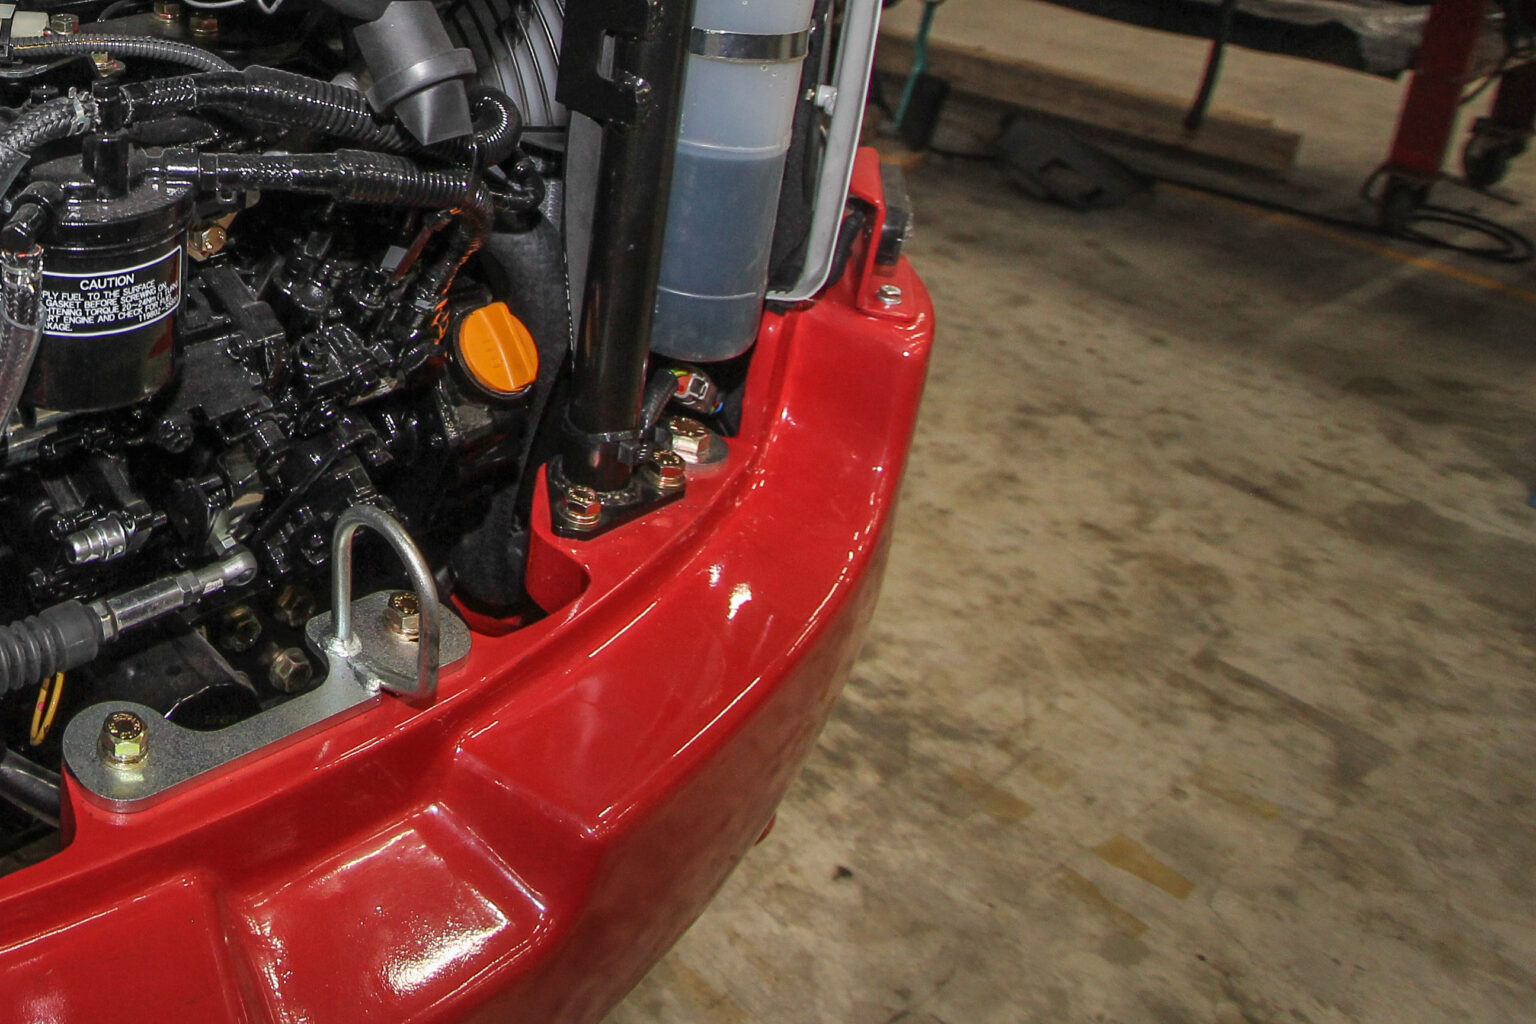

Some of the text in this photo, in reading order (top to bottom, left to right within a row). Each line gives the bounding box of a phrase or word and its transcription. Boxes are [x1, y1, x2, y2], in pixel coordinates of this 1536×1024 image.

[42, 279, 156, 302] PLY FUEL TO THE SURFACE
[80, 273, 135, 291] CAUTION
[46, 299, 82, 310] GASKET
[84, 297, 118, 309] BEFORE
[120, 286, 157, 305] SCREWING
[63, 316, 95, 325] ENGINE
[97, 314, 116, 323] AND
[117, 308, 144, 320] CHECK
[144, 301, 159, 313] FOR
[85, 305, 119, 316] TORQUE
[46, 322, 73, 332] KAGE.
